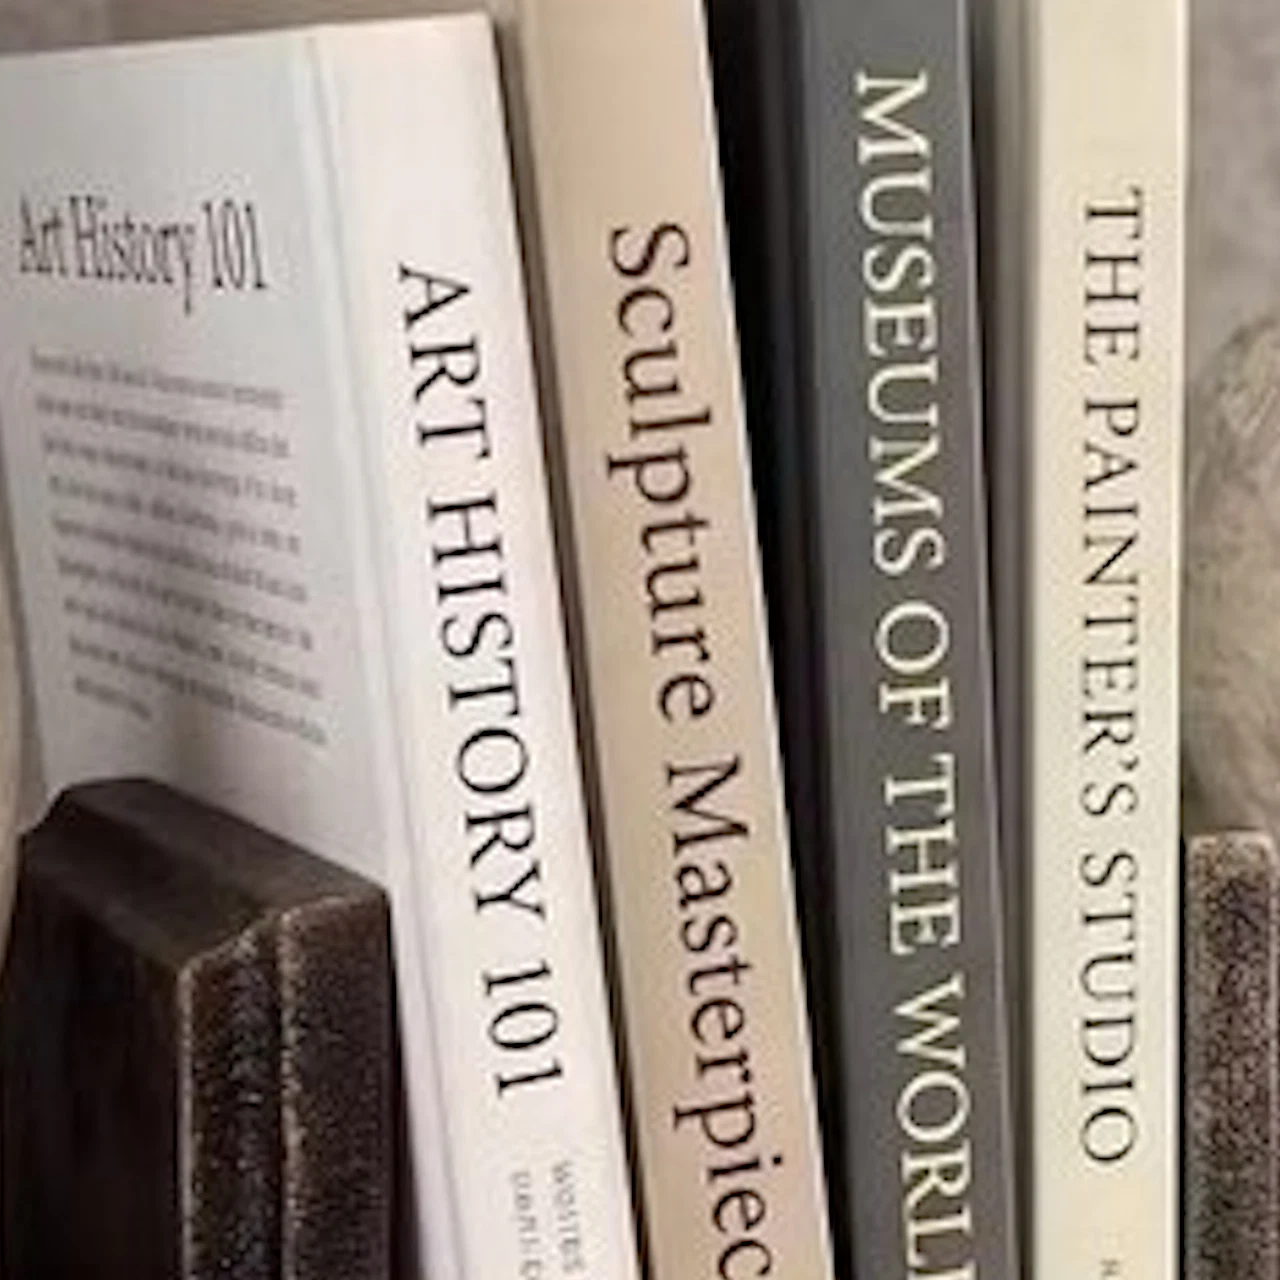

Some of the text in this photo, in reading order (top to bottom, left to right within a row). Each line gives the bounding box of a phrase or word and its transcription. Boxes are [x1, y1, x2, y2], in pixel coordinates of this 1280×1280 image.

[19, 194, 268, 317] Art History 101
[856, 72, 946, 576] MUSEUMS
[1083, 186, 1142, 365] THE
[399, 263, 491, 461] ART
[606, 222, 712, 721] Sculpture
[427, 494, 546, 921] HISTORY
[876, 601, 951, 730] OF
[884, 752, 961, 956] THE
[481, 960, 564, 1098] 101
[1080, 850, 1138, 1164] STUDIO
